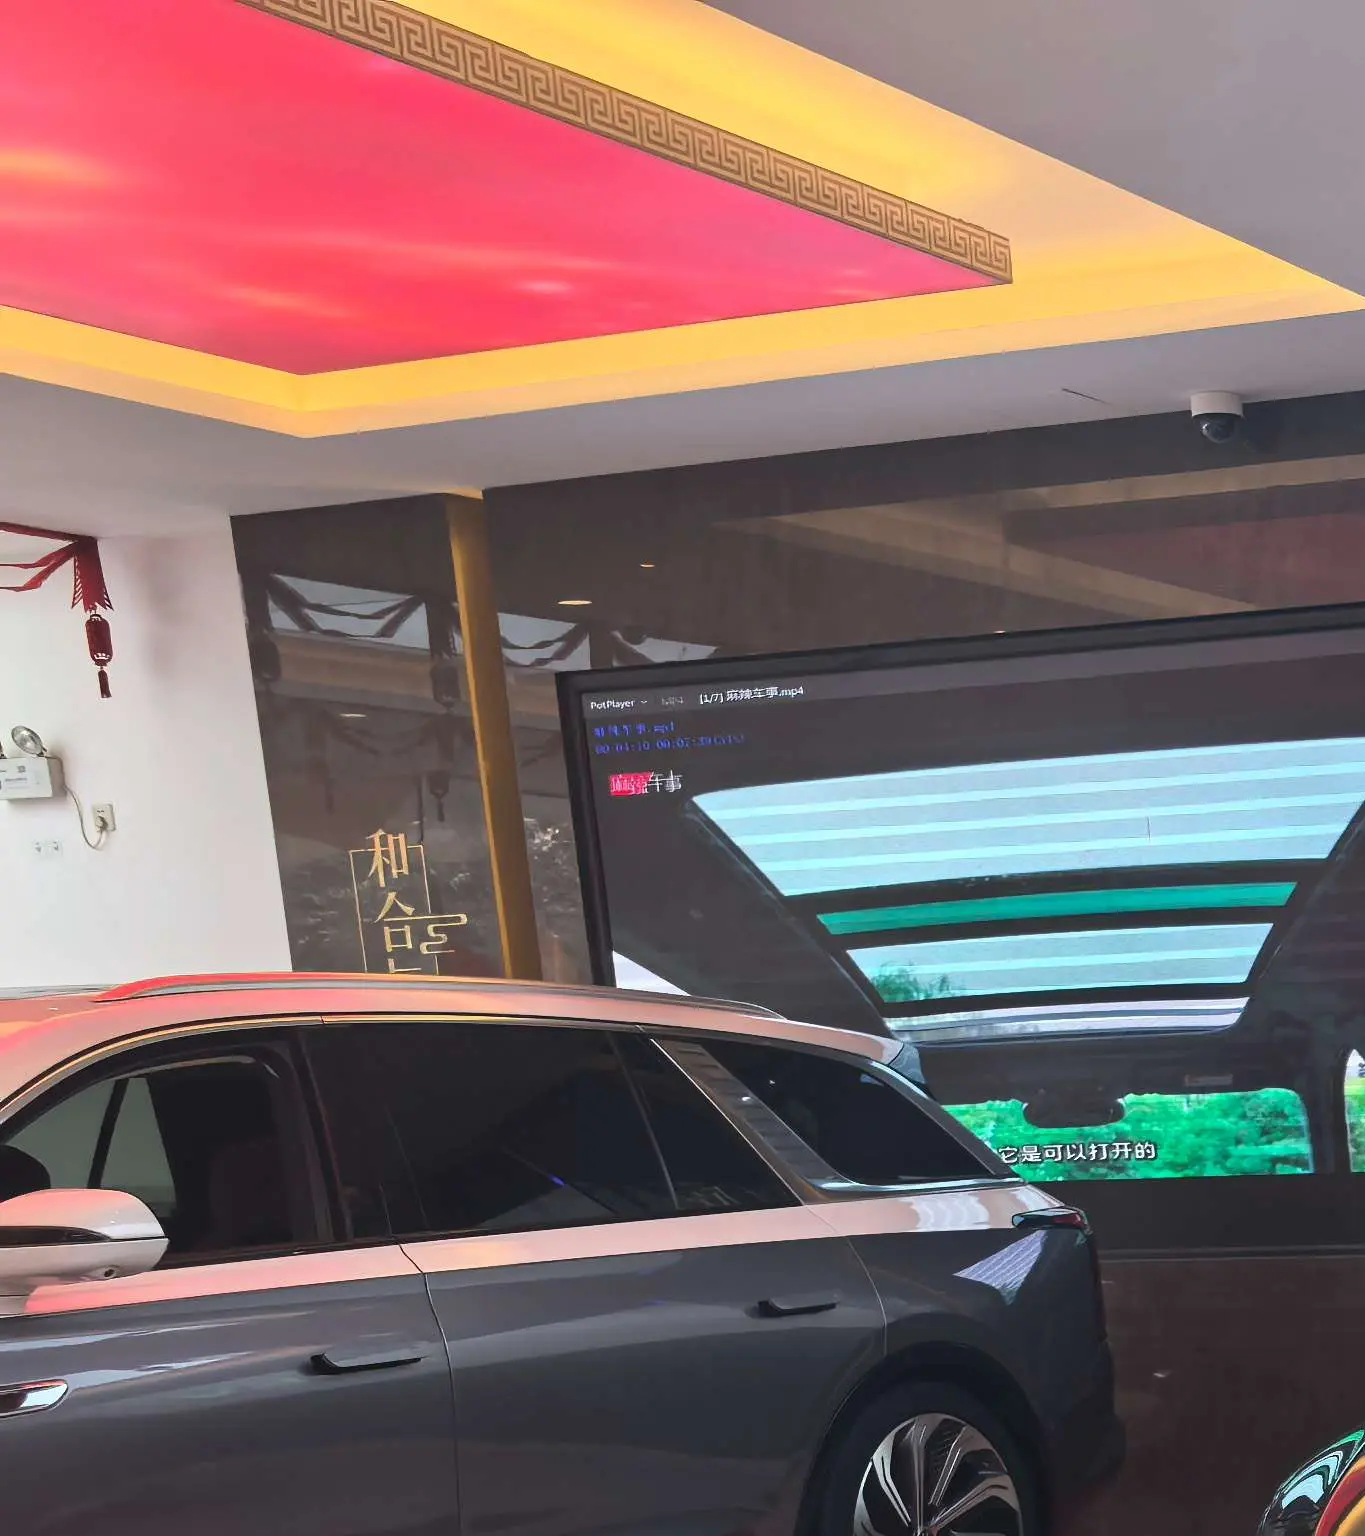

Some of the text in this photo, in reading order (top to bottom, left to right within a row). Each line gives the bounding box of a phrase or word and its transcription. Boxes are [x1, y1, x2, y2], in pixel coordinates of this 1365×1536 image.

[590, 700, 635, 709] PotPlayer
[366, 829, 422, 973] 和合
[999, 1142, 1156, 1164] 它是可以打开的
